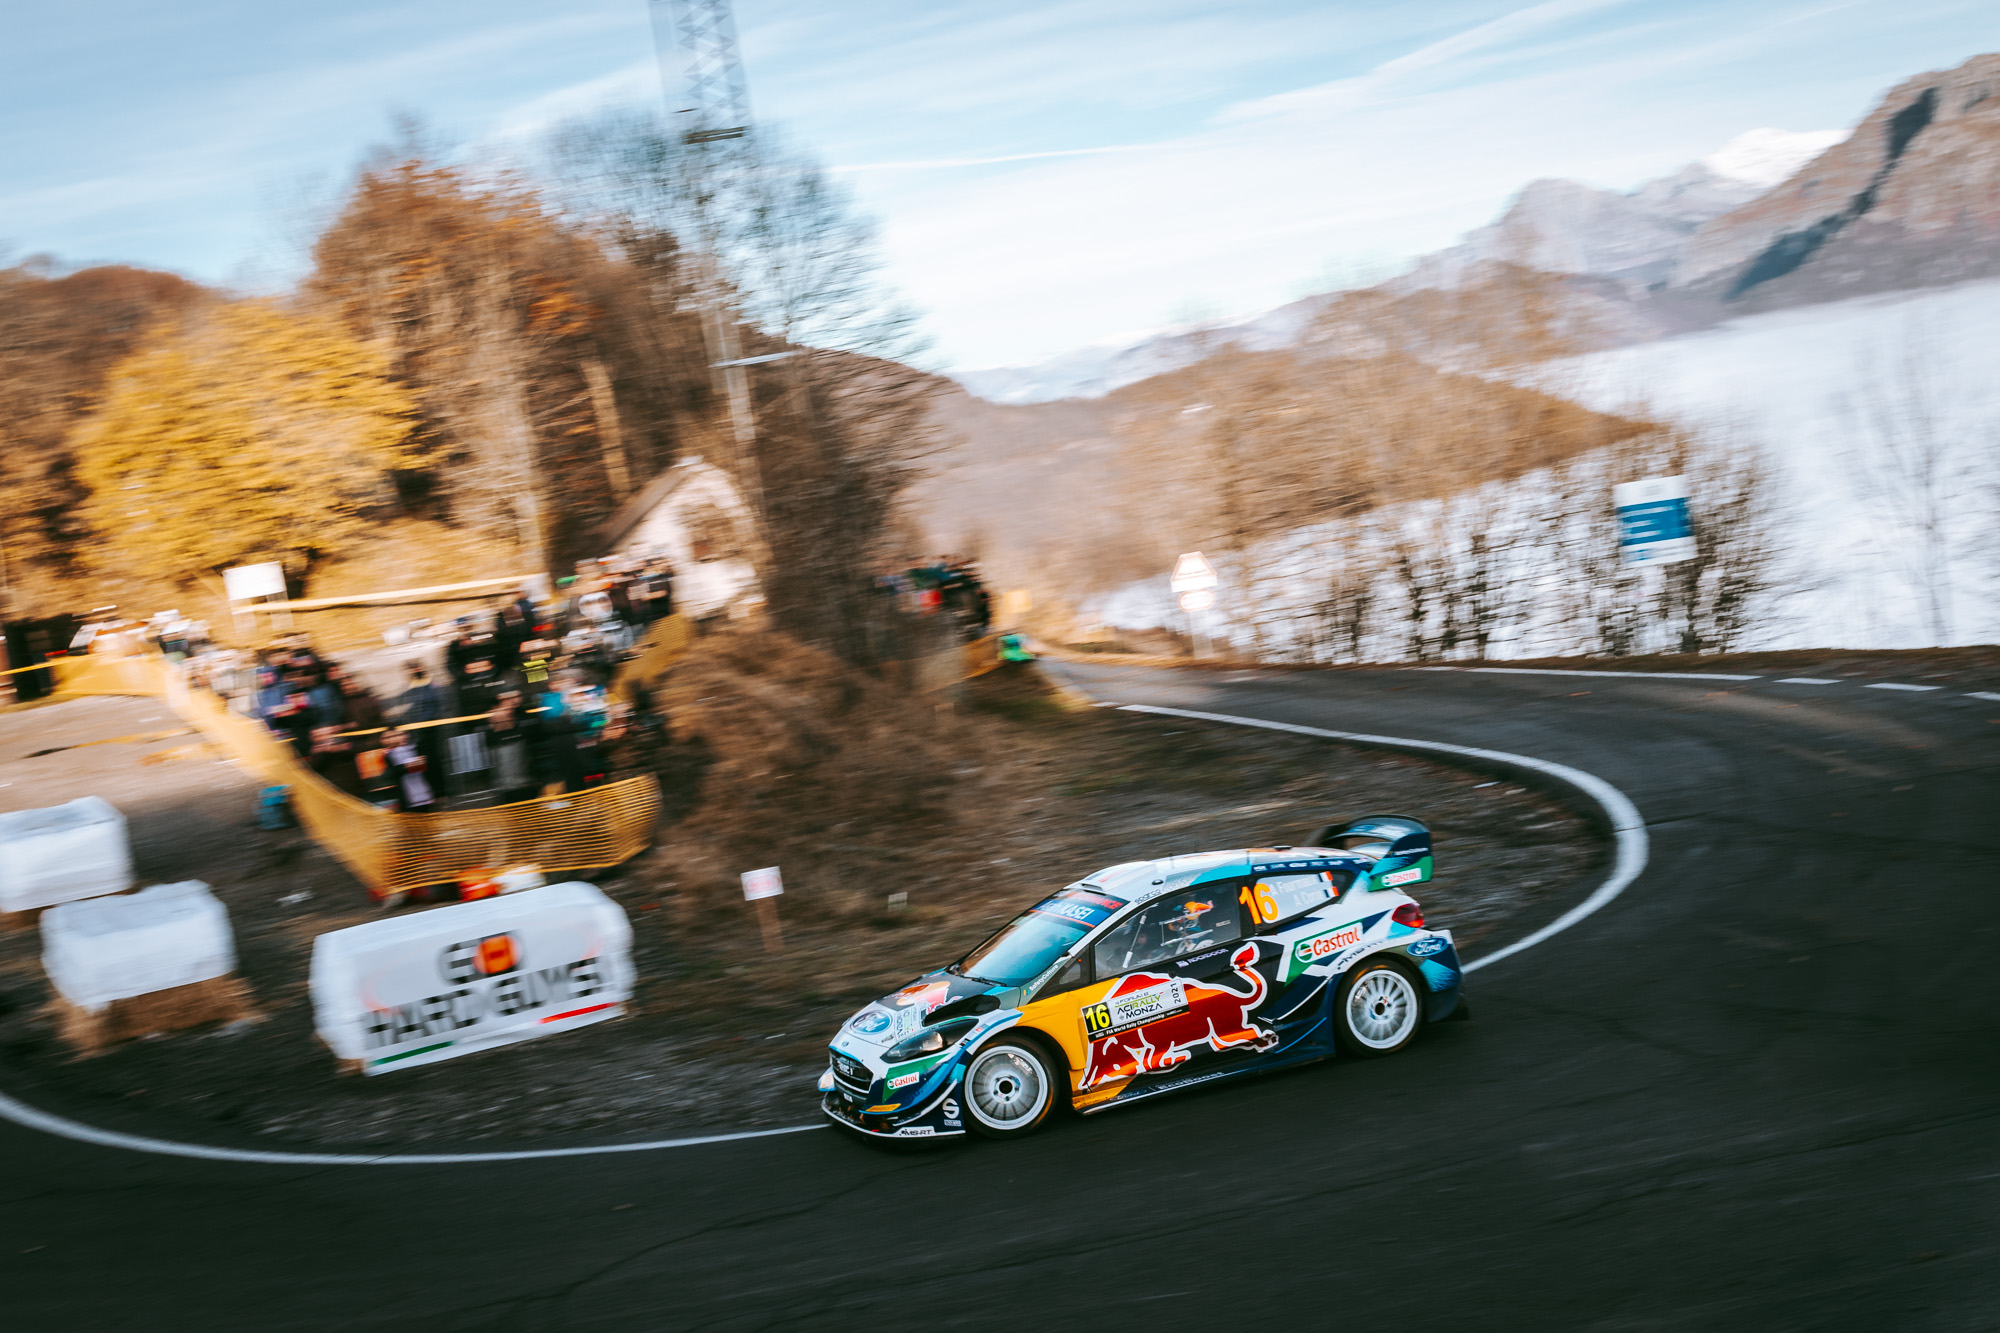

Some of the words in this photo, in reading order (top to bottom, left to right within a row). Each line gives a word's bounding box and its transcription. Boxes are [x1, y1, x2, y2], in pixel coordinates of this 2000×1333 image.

[1239, 883, 1279, 925] 16
[1313, 927, 1360, 956] Castrol
[1414, 937, 1444, 956] Ford
[1029, 964, 1058, 991] SafetyCulture
[1170, 982, 1182, 1004] 2021
[1086, 1004, 1110, 1031] 16
[1125, 1003, 1163, 1019] MONZA
[894, 1074, 918, 1088] Castrol
